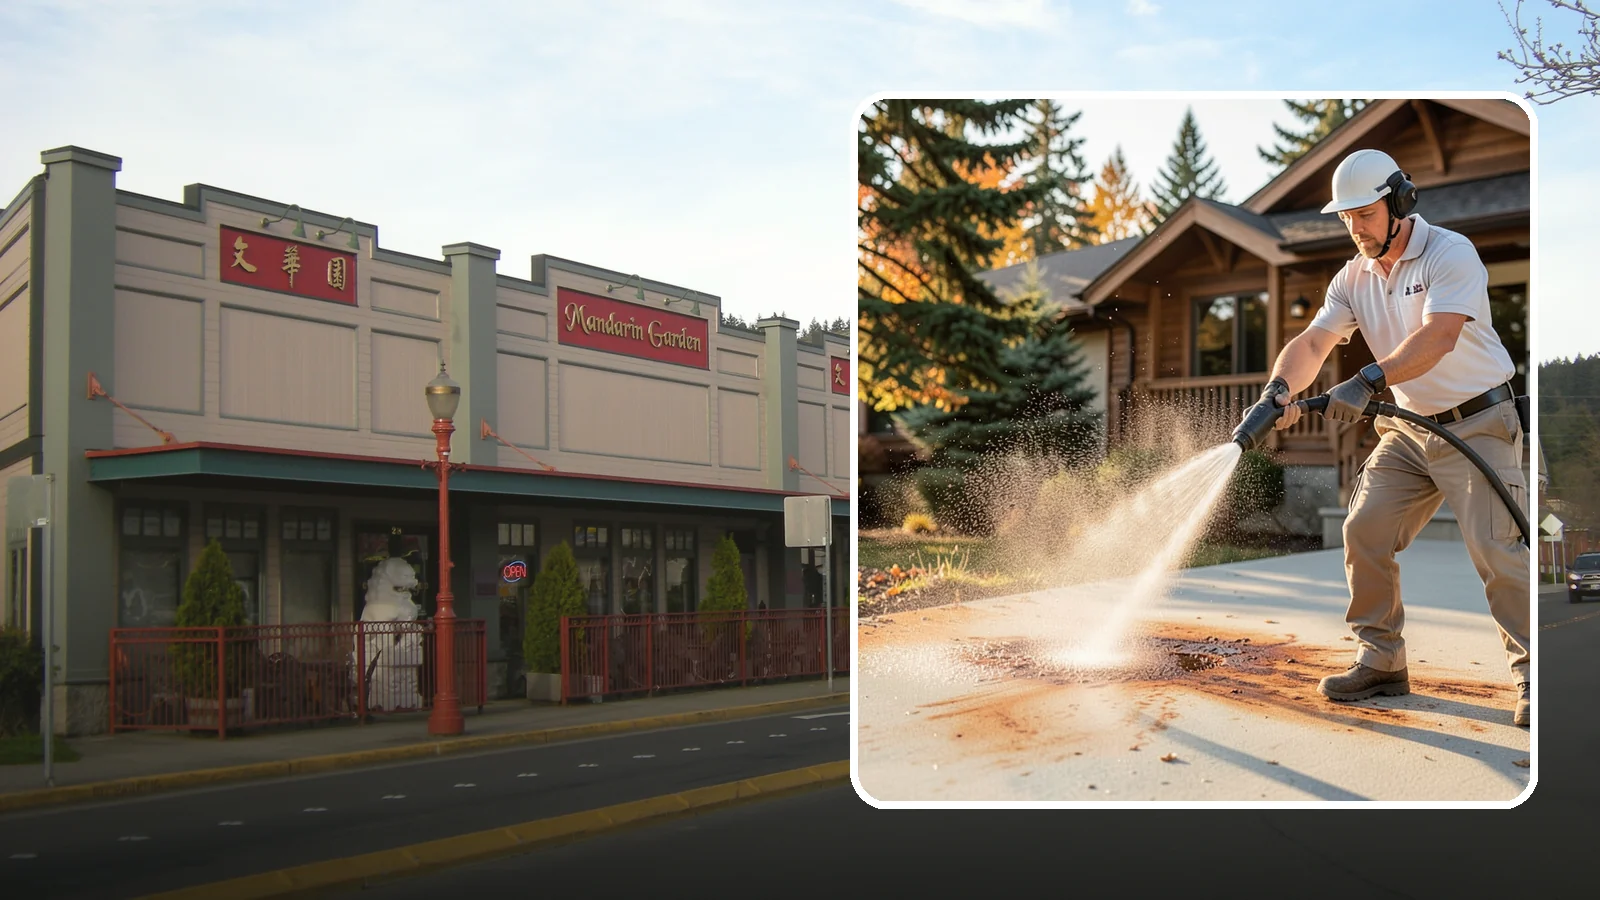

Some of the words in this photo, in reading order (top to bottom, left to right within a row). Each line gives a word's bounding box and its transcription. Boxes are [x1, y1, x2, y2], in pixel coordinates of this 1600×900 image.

[231, 236, 346, 291] 文華園
[564, 303, 643, 341] Mandarin
[648, 320, 701, 352] Garden
[503, 565, 527, 578] OPEN
